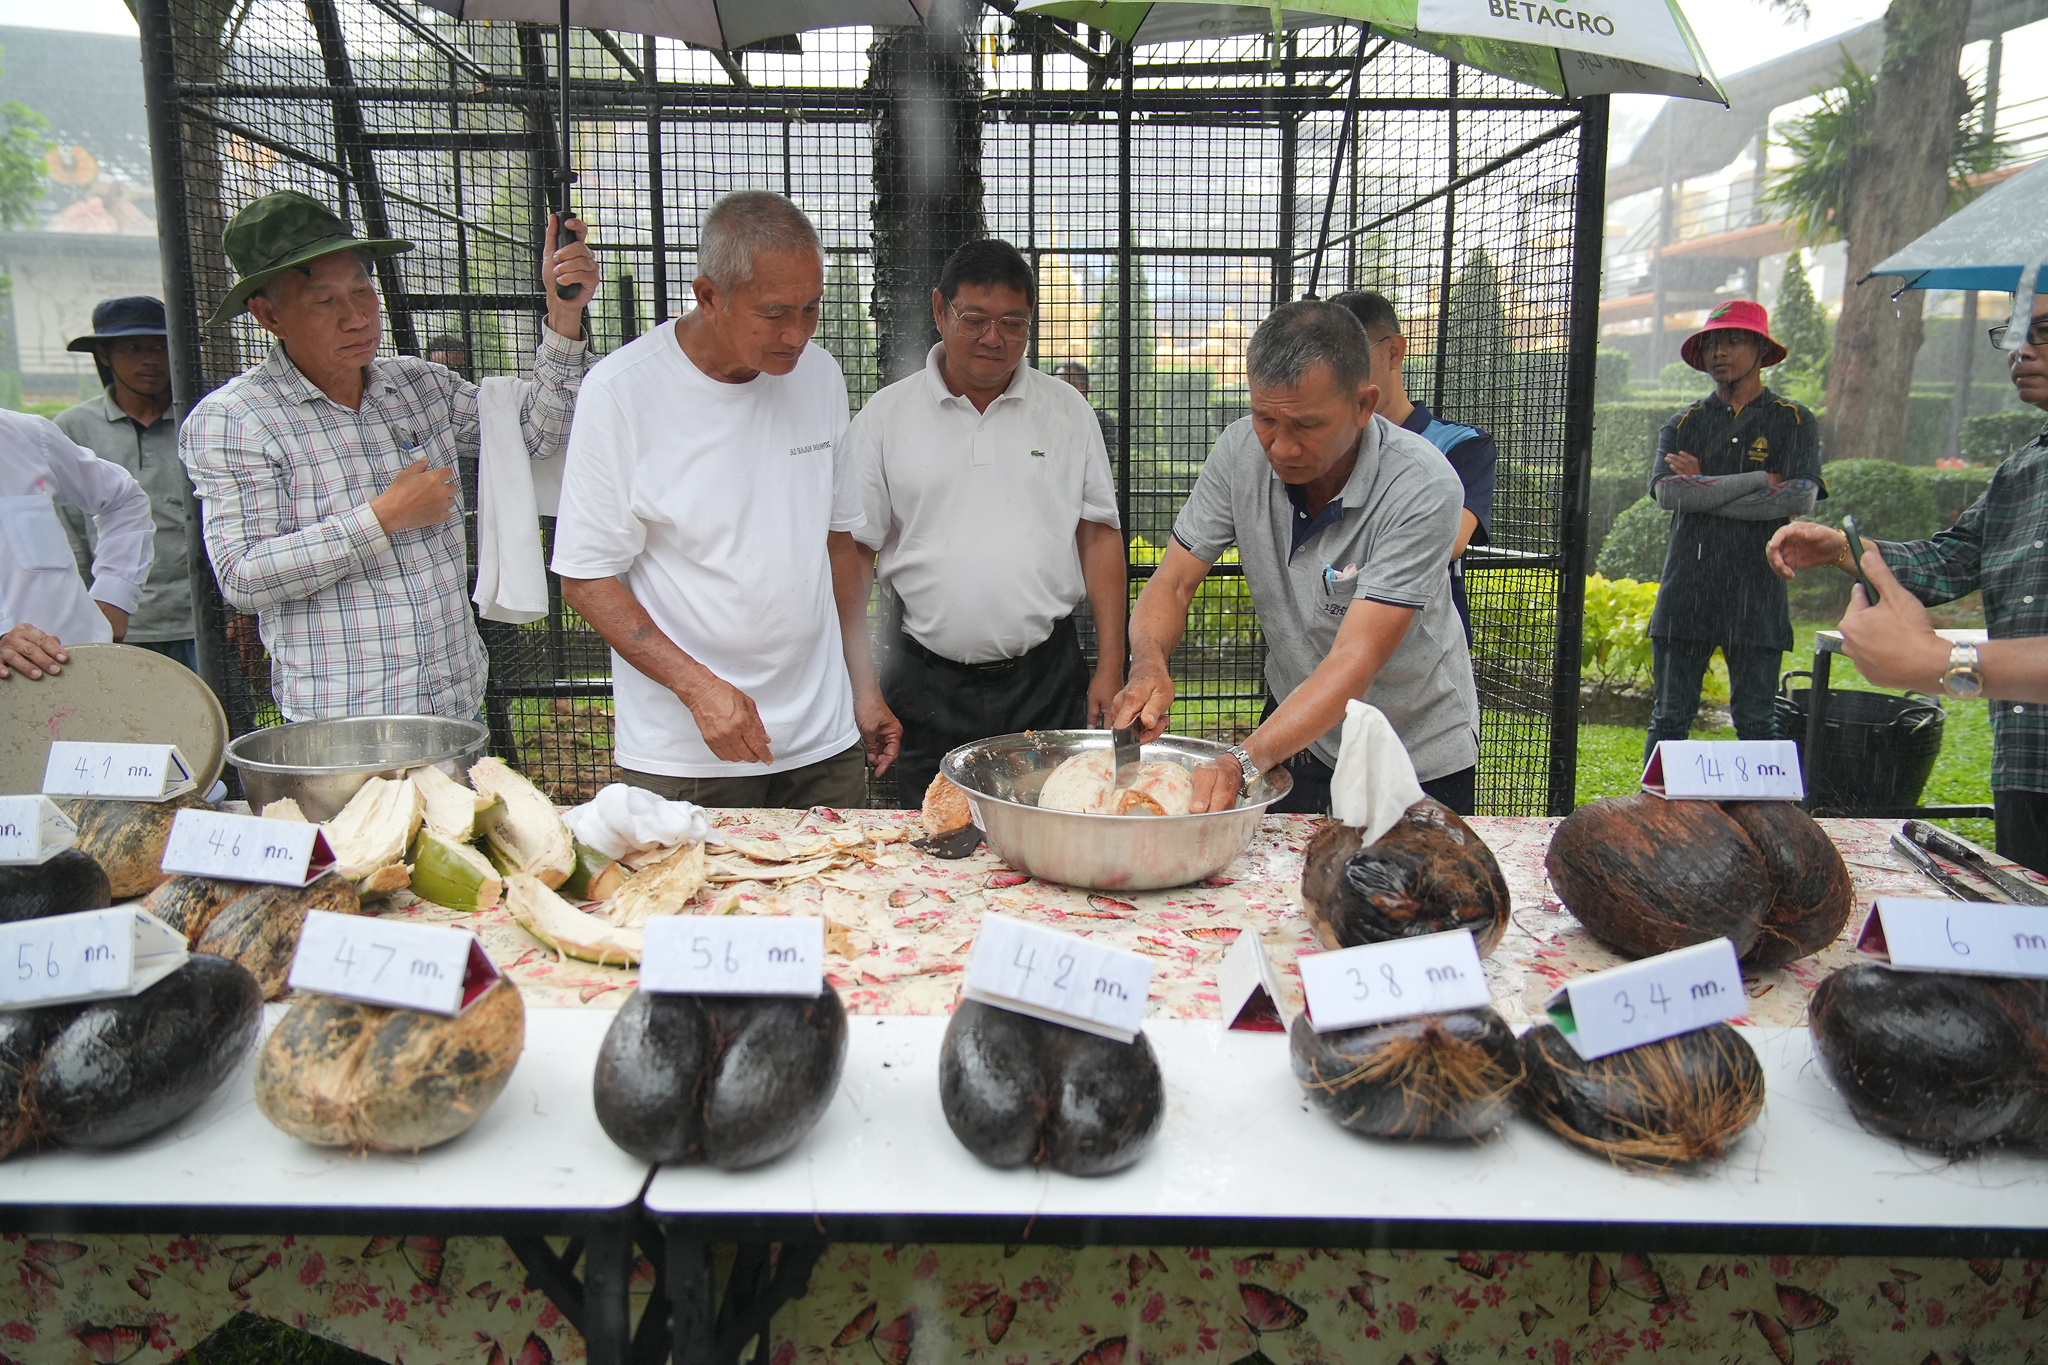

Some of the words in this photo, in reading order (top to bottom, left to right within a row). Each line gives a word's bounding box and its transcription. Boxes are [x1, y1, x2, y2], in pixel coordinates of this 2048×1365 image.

[1488, 0, 1615, 37] BETAGRO
[75, 756, 111, 779] 4.1
[128, 766, 152, 777] กก.
[1757, 764, 1786, 776] กก.
[209, 829, 241, 857] 4.6
[264, 845, 293, 860] กก.
[1946, 917, 1970, 955] 6
[18, 942, 59, 980] 5.6
[84, 945, 115, 963] กก.
[768, 947, 804, 963] กก.
[410, 959, 443, 979] กก.
[1425, 965, 1465, 983] กก.
[1094, 977, 1129, 1001] กก.
[1690, 980, 1725, 1001] กก.
